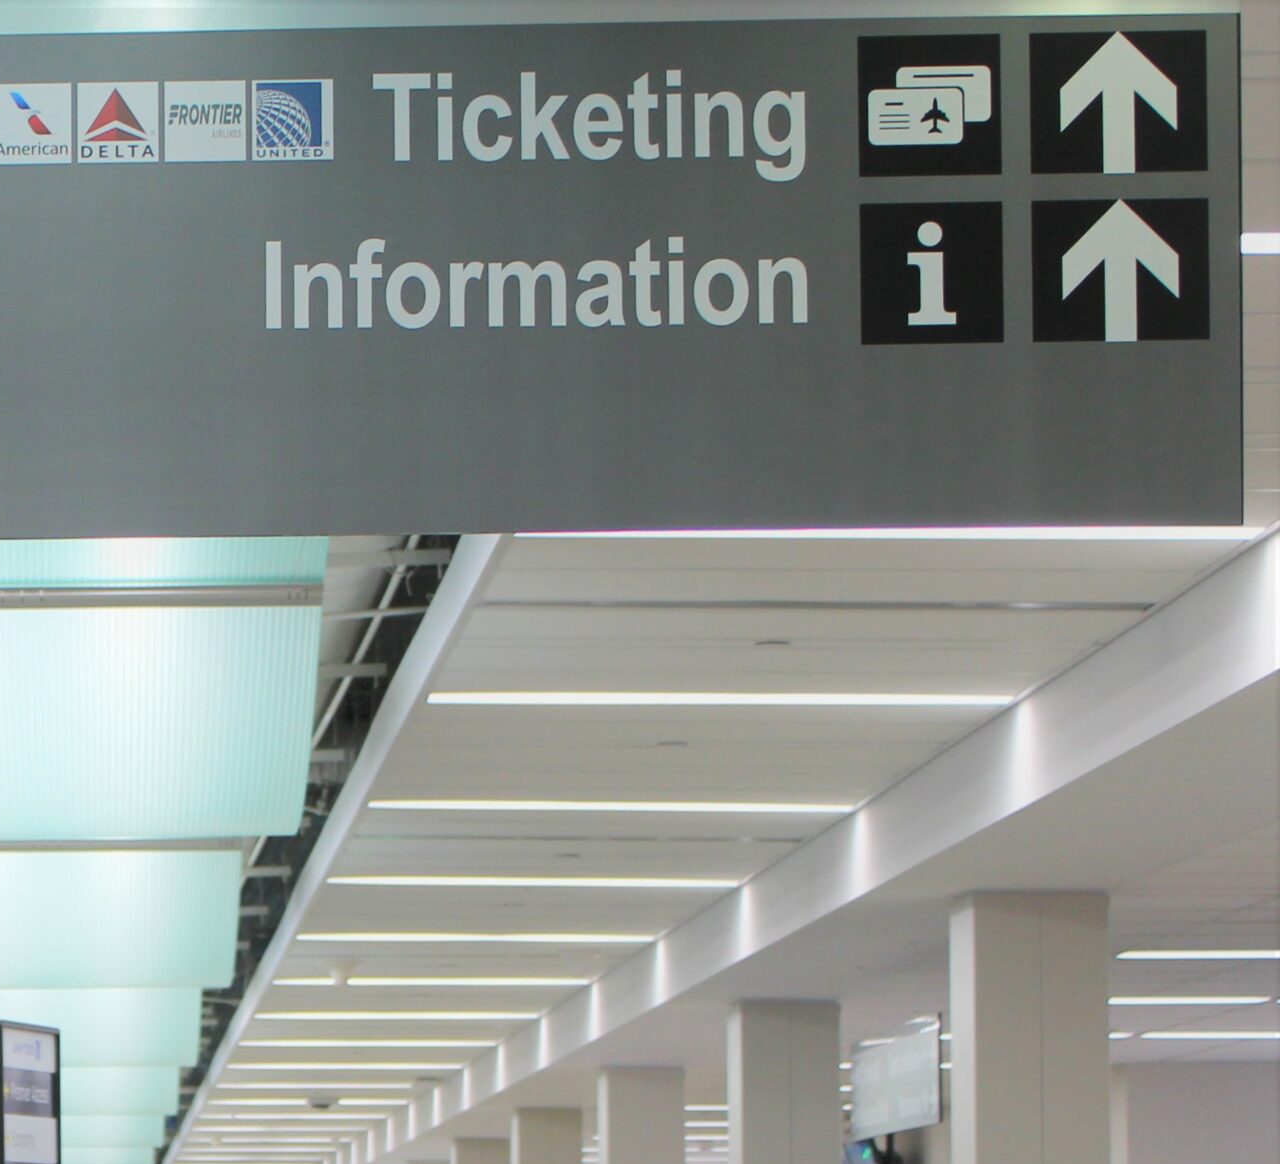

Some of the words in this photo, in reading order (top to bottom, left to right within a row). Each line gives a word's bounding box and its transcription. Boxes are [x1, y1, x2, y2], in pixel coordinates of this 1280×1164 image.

[168, 103, 243, 126] FRONTIER
[372, 69, 806, 182] Ticketing
[81, 145, 155, 158] DELTA
[256, 148, 324, 158] UNITED
[265, 236, 808, 330] Information
